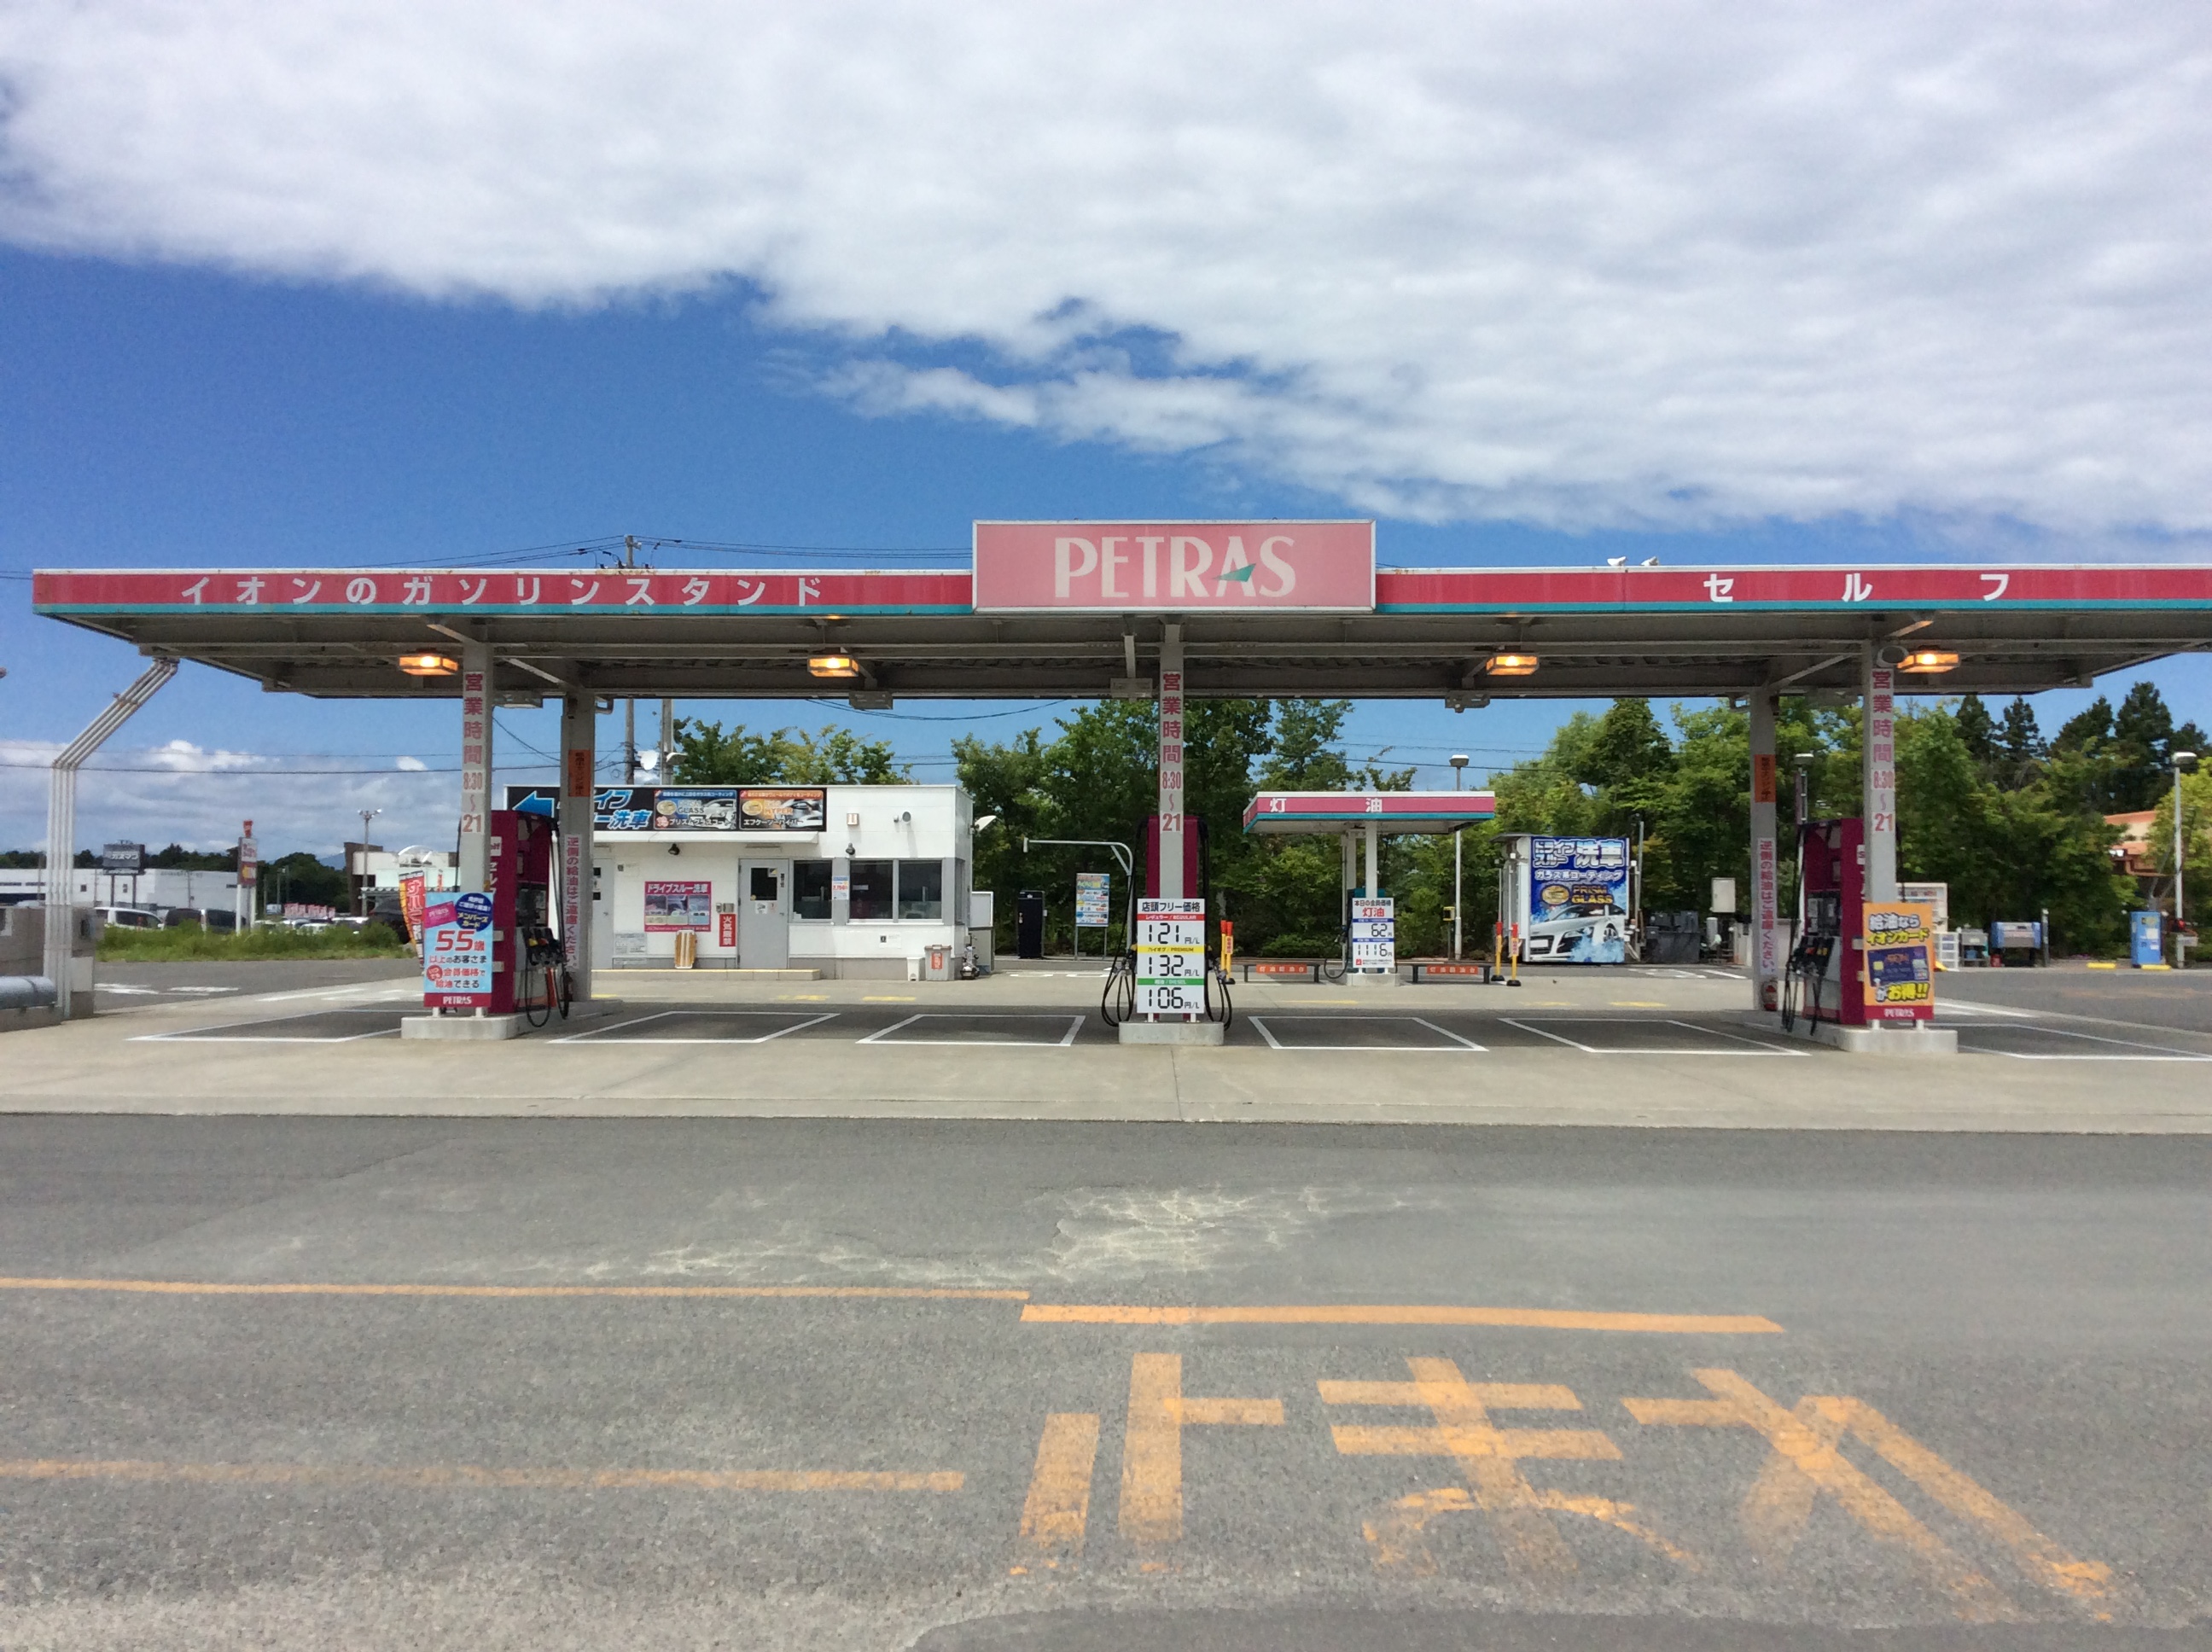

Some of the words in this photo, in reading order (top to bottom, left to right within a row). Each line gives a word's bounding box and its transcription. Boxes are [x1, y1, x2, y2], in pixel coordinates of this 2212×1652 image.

[1055, 535, 1297, 598] PETRAS
[181, 576, 821, 607] イオンのガソリンスタンド
[1703, 573, 2010, 602] セルフ
[1269, 797, 1382, 813] 灯油
[1575, 840, 1623, 867] 洗車
[1142, 901, 1201, 912] 店頭フリー価格
[1571, 894, 1613, 904] GLASS
[1362, 907, 1385, 917] 灯油
[1149, 922, 1179, 945] 121
[1371, 923, 1388, 938] 62
[1149, 954, 1184, 977] 132
[435, 980, 480, 989] 給油できる
[442, 996, 473, 1005] PETRAS
[1149, 986, 1184, 1009] 106
[1883, 1008, 1915, 1017] PETRAS
